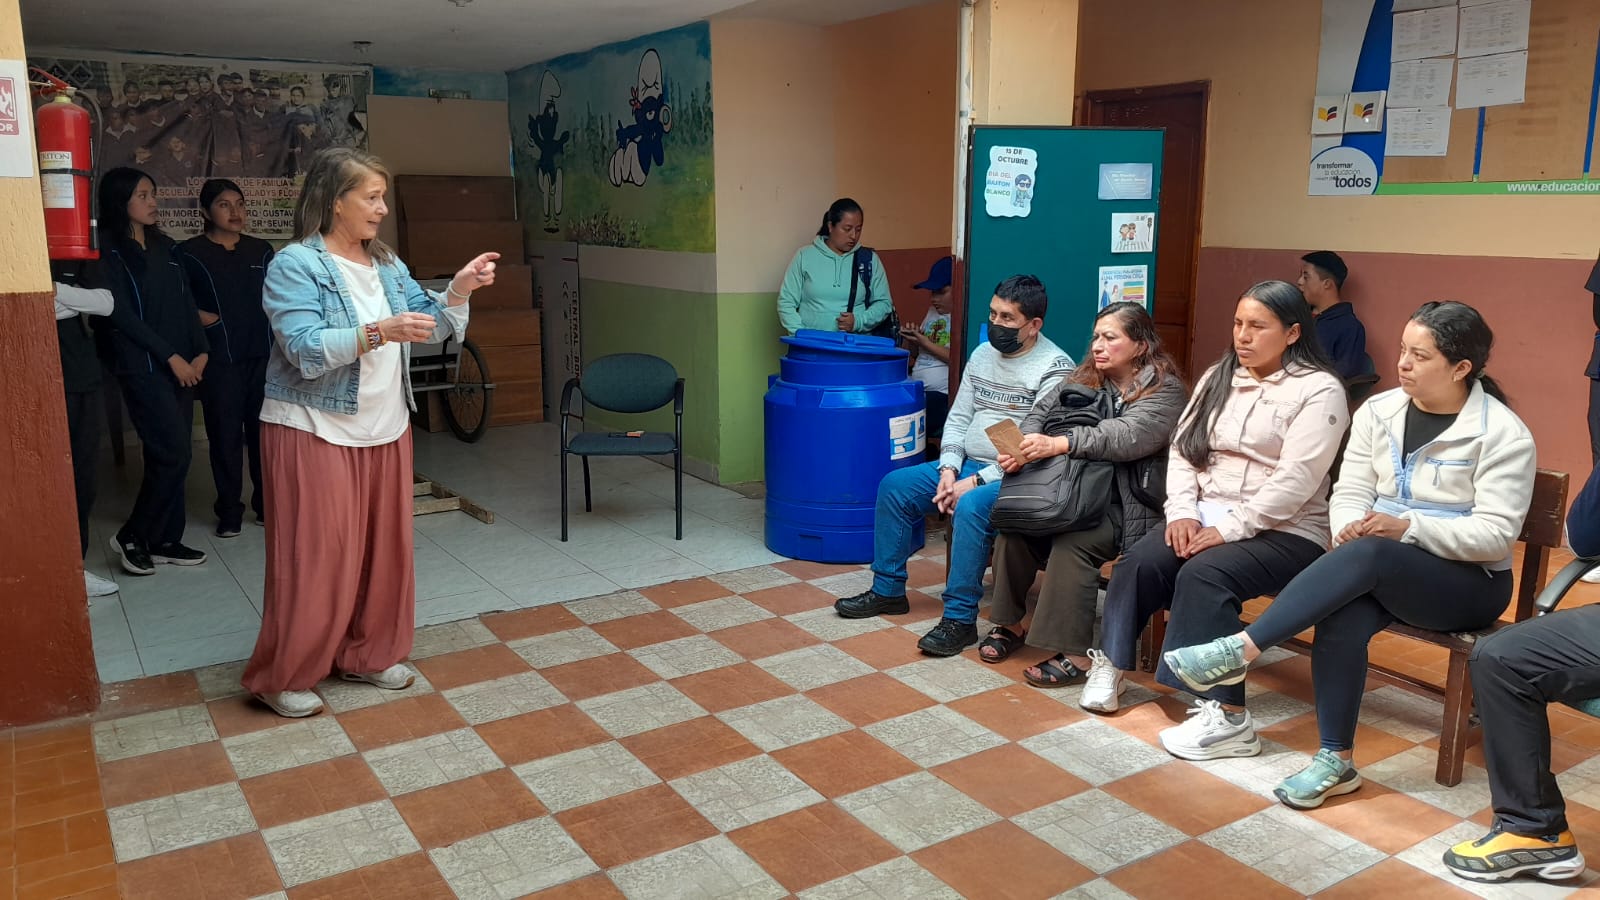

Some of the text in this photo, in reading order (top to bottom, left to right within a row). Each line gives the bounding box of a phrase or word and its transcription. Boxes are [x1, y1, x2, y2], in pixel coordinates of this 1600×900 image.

[998, 156, 1028, 165] OCTUBRE
[243, 179, 254, 187] DE
[257, 179, 288, 187] FAMILIA
[1336, 174, 1372, 188] todos
[571, 291, 579, 347] CENTRAL
